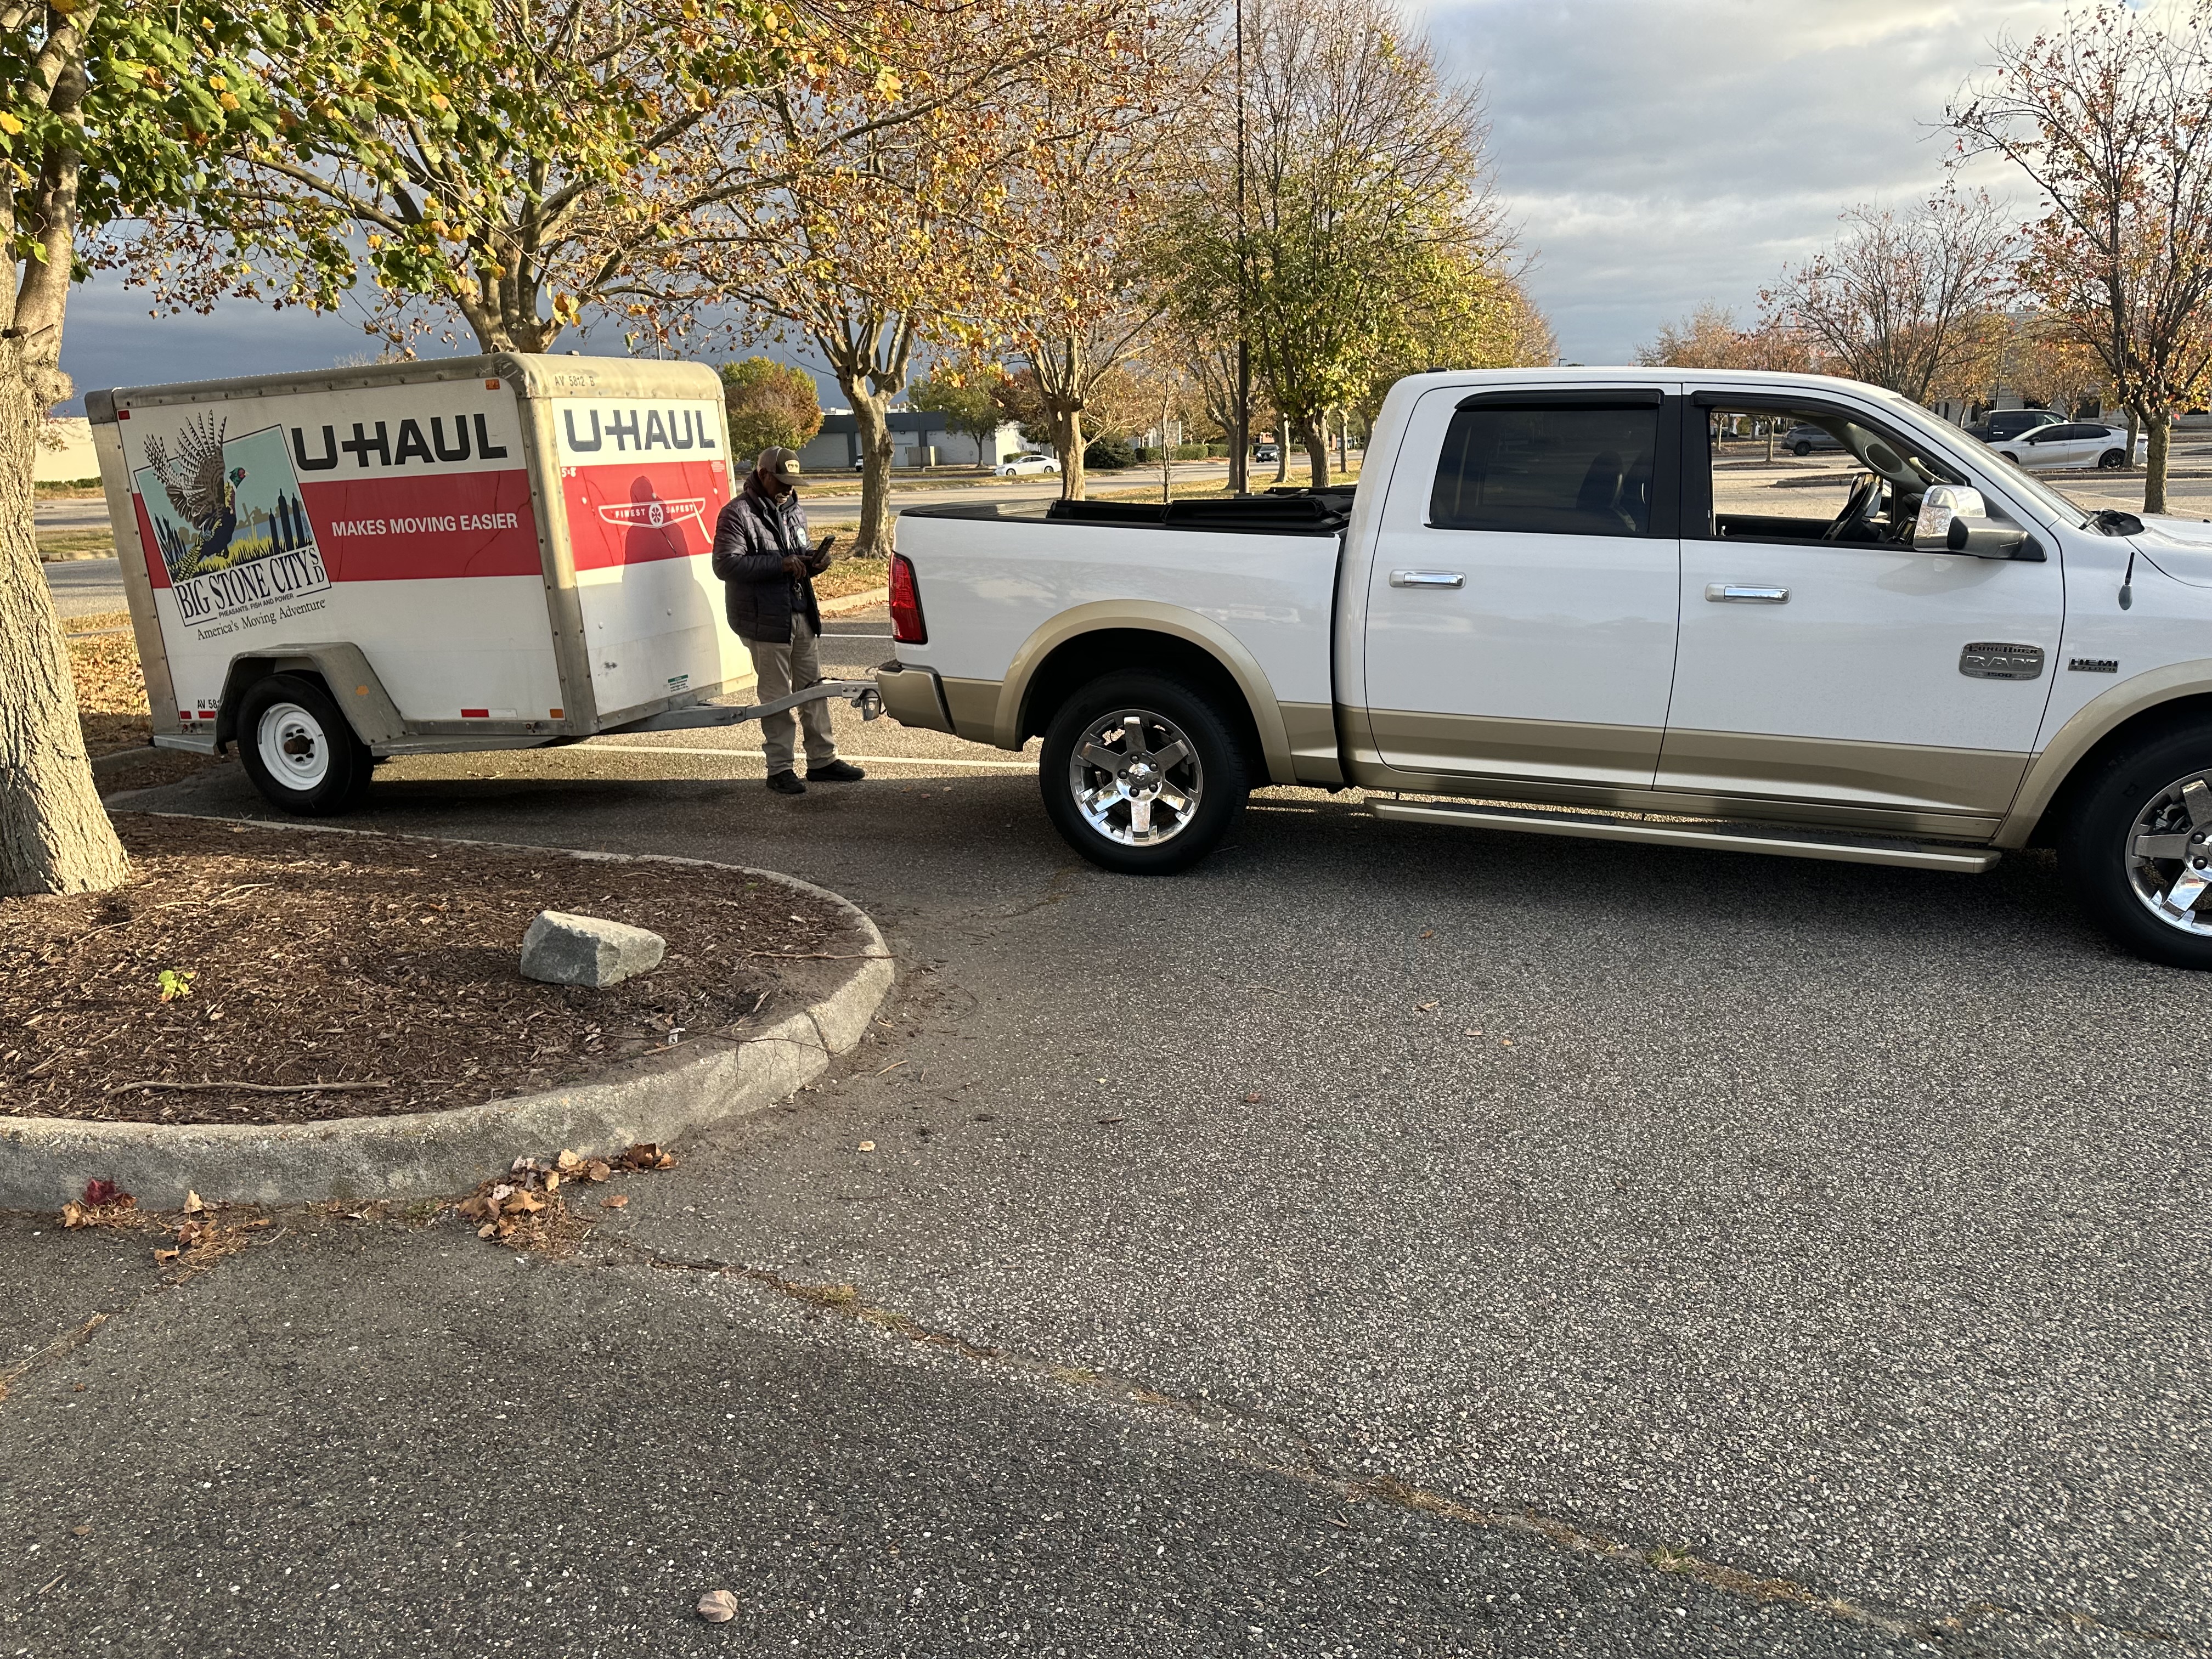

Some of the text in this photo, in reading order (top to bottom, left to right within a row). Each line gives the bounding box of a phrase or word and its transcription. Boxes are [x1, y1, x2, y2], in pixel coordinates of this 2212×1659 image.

[555, 375, 595, 386] AV 5812 B
[563, 409, 716, 452] U-HAUL
[291, 413, 508, 471] U-HAUL
[615, 504, 694, 518] FINEST SAFEST
[331, 520, 386, 537] MAKES
[390, 516, 456, 534] MOVING
[460, 513, 518, 531] EASIER
[175, 579, 211, 619] BIG
[208, 563, 270, 610] STONE
[269, 550, 313, 594] CITY
[250, 601, 263, 610] FISH
[263, 598, 274, 606] AND
[275, 593, 294, 603] POWER
[198, 599, 326, 641] America's Moving Adventure
[2070, 658, 2118, 667] HEMI
[198, 699, 205, 709] AV
